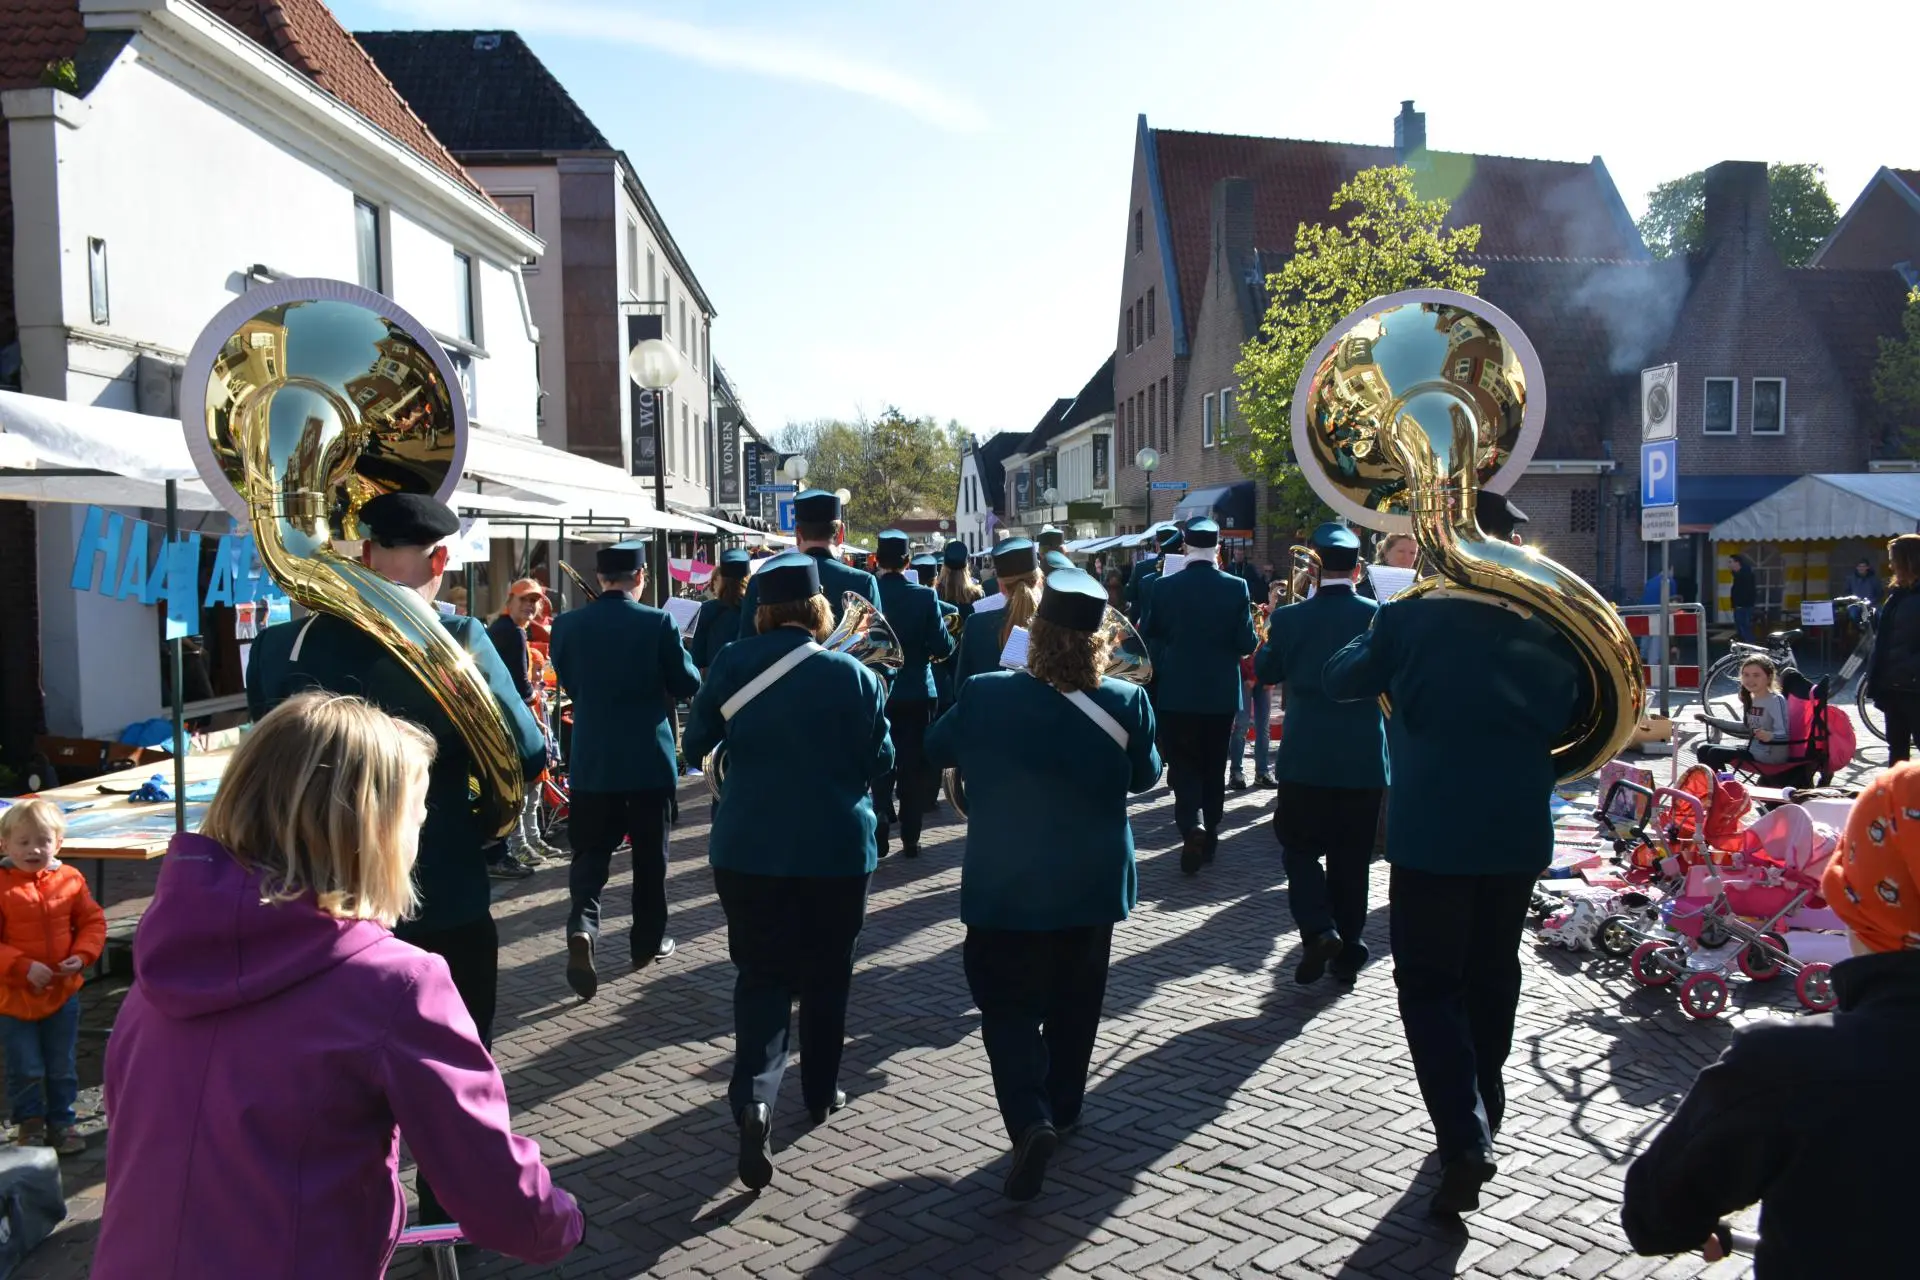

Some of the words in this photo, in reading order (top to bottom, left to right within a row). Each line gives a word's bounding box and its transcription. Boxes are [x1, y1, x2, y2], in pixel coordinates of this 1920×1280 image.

[722, 421, 733, 475] WONEN
[748, 446, 757, 496] TEXTIEL
[764, 468, 773, 505] SLEN
[1648, 450, 1668, 499] P
